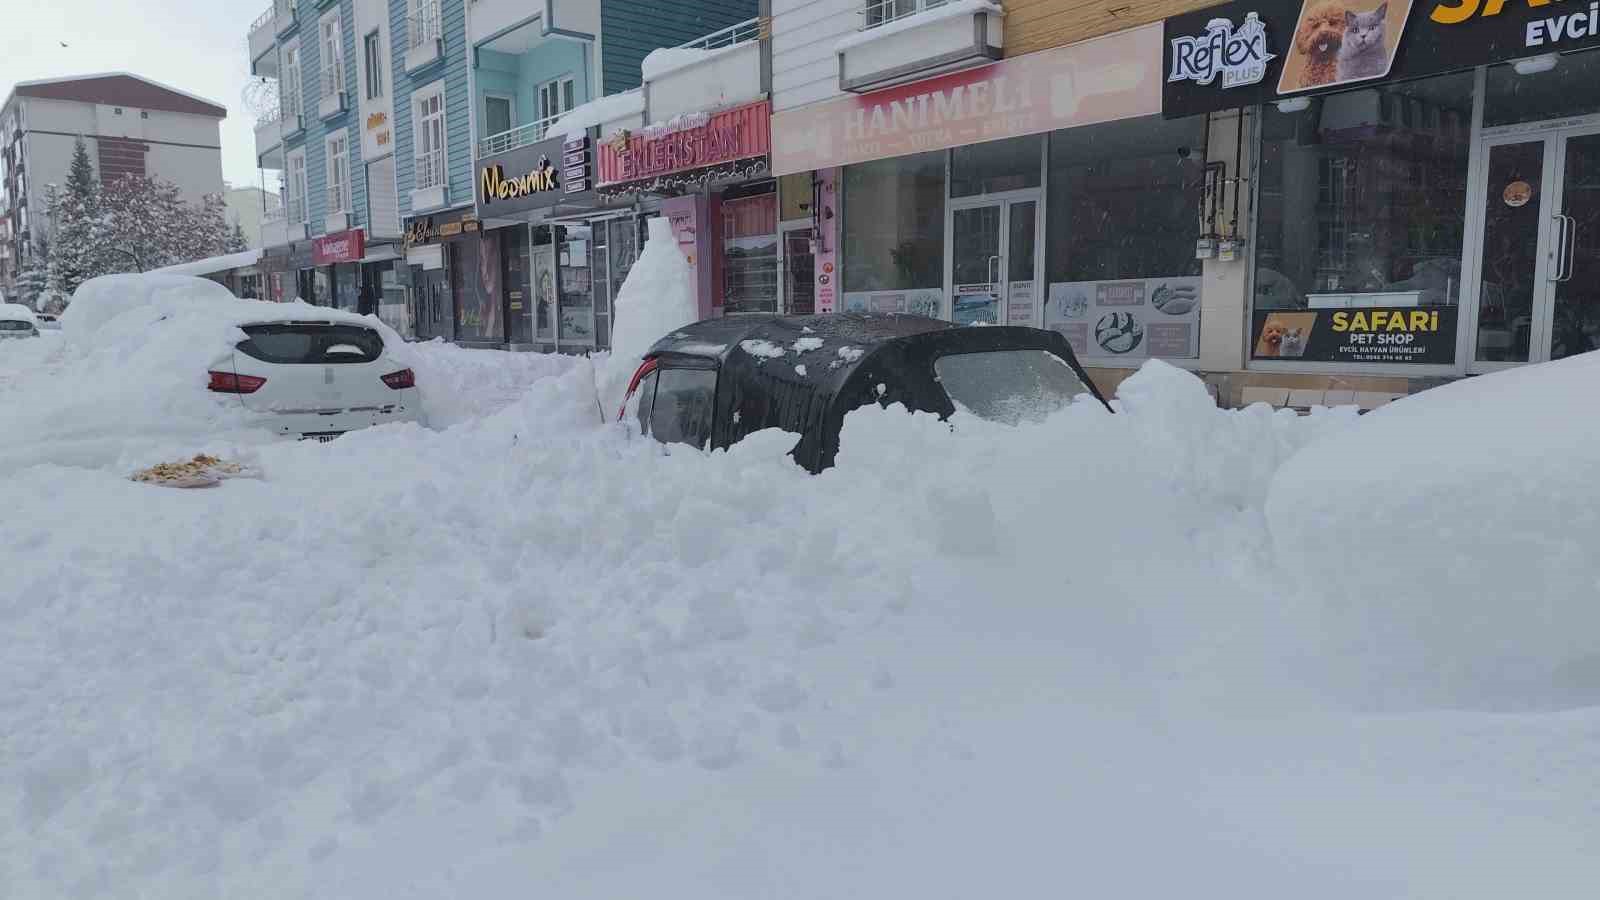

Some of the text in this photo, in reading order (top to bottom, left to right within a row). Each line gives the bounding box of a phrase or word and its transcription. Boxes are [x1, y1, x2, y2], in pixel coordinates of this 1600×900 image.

[1175, 29, 1261, 80] Reflex
[1226, 67, 1259, 83] PLUS
[1350, 333, 1414, 344] PET SHOP
